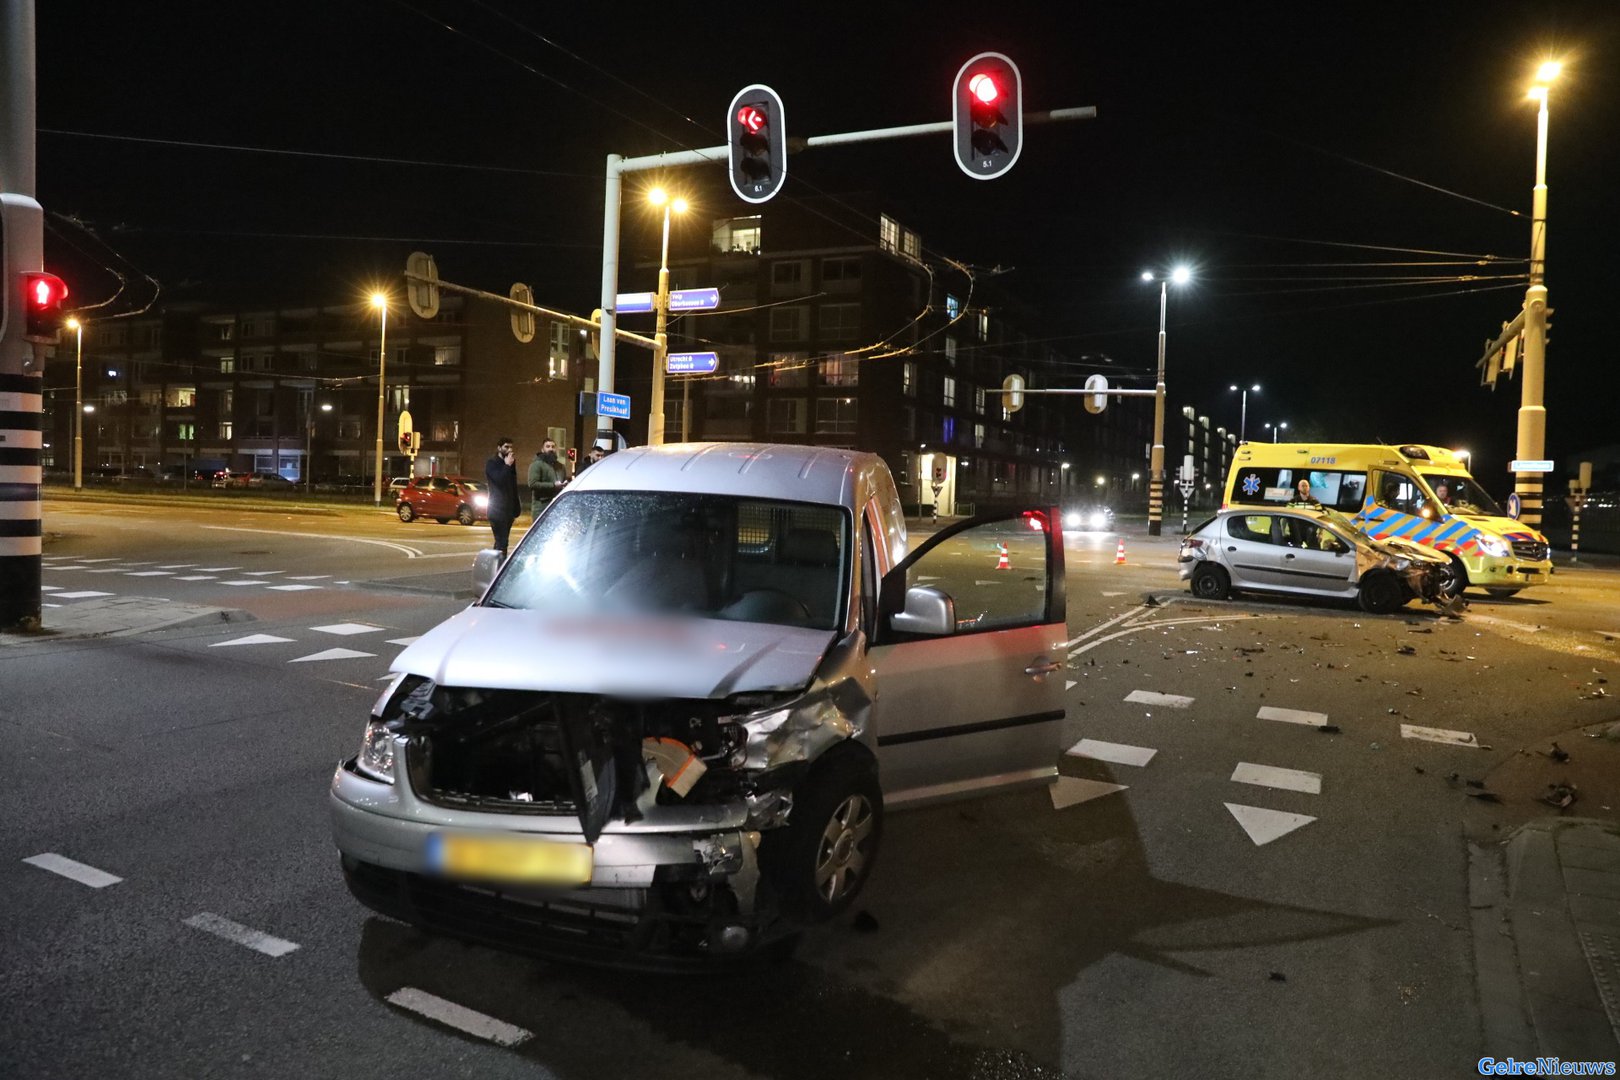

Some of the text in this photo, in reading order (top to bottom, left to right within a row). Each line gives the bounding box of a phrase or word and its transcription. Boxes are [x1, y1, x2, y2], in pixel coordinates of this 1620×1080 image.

[603, 395, 616, 404] Laan
[600, 404, 627, 414] Presikhaaf
[1310, 456, 1335, 464] 07118
